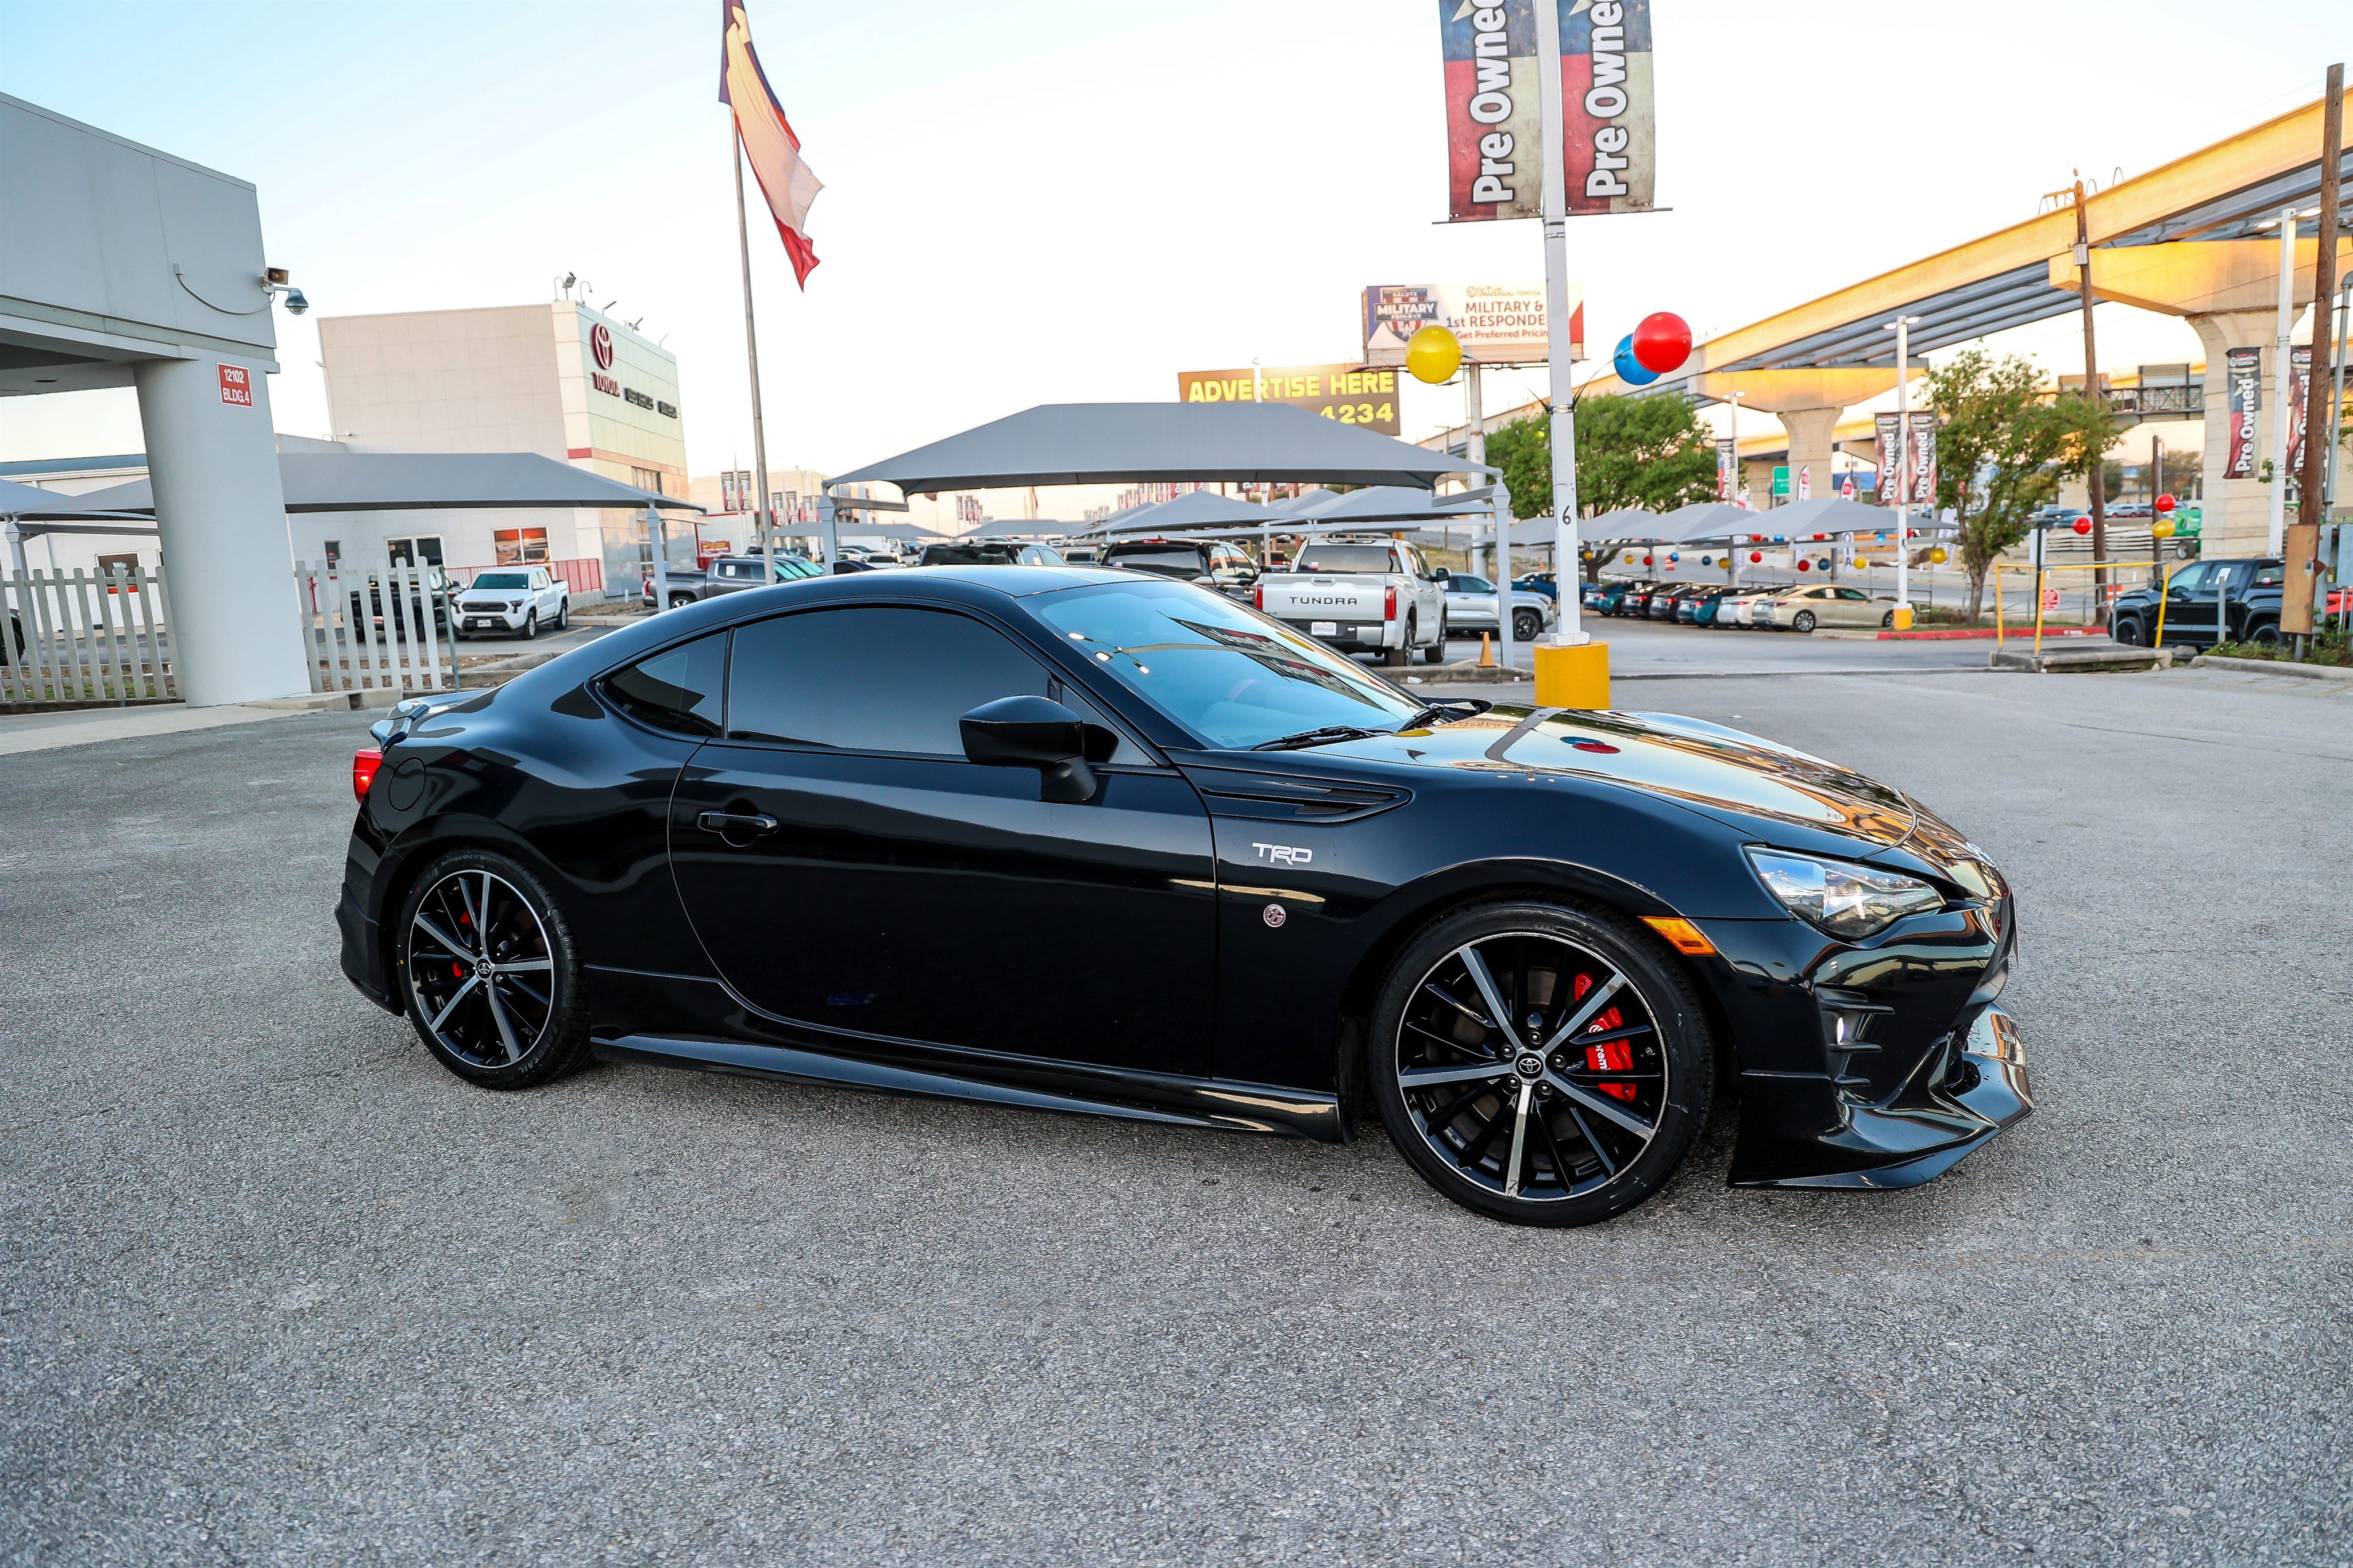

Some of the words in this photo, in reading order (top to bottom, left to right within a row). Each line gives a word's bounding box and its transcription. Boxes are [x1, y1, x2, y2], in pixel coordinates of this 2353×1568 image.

[1584, 0, 1628, 118] Owne
[1472, 132, 1515, 203] Pre
[1586, 126, 1629, 198] Pre
[1377, 303, 1435, 315] MILITARY
[1465, 301, 1530, 314] MILITARY
[1534, 300, 1544, 312] &
[1446, 316, 1466, 328] 1st
[1470, 314, 1546, 327] RESPONDE
[1456, 330, 1472, 339] Get
[1475, 330, 1519, 339] Preferred
[1522, 329, 1549, 338] Pricin
[223, 368, 245, 384] 12102
[591, 372, 620, 397] TOYOTA
[1189, 374, 1320, 403] ADVERTISE
[1329, 371, 1394, 396] HERE
[2237, 377, 2255, 440] Owned
[1881, 432, 1896, 477] Owned
[1914, 432, 1929, 477] Owned
[2234, 442, 2254, 472] Pre
[1722, 452, 1732, 482] Owned
[1721, 483, 1731, 499] Pre
[1880, 477, 1896, 500] Pre
[1914, 477, 1929, 499] Pre
[1563, 505, 1571, 525] 6
[1289, 596, 1357, 605] TUNDRA
[1251, 842, 1314, 866] TRD
